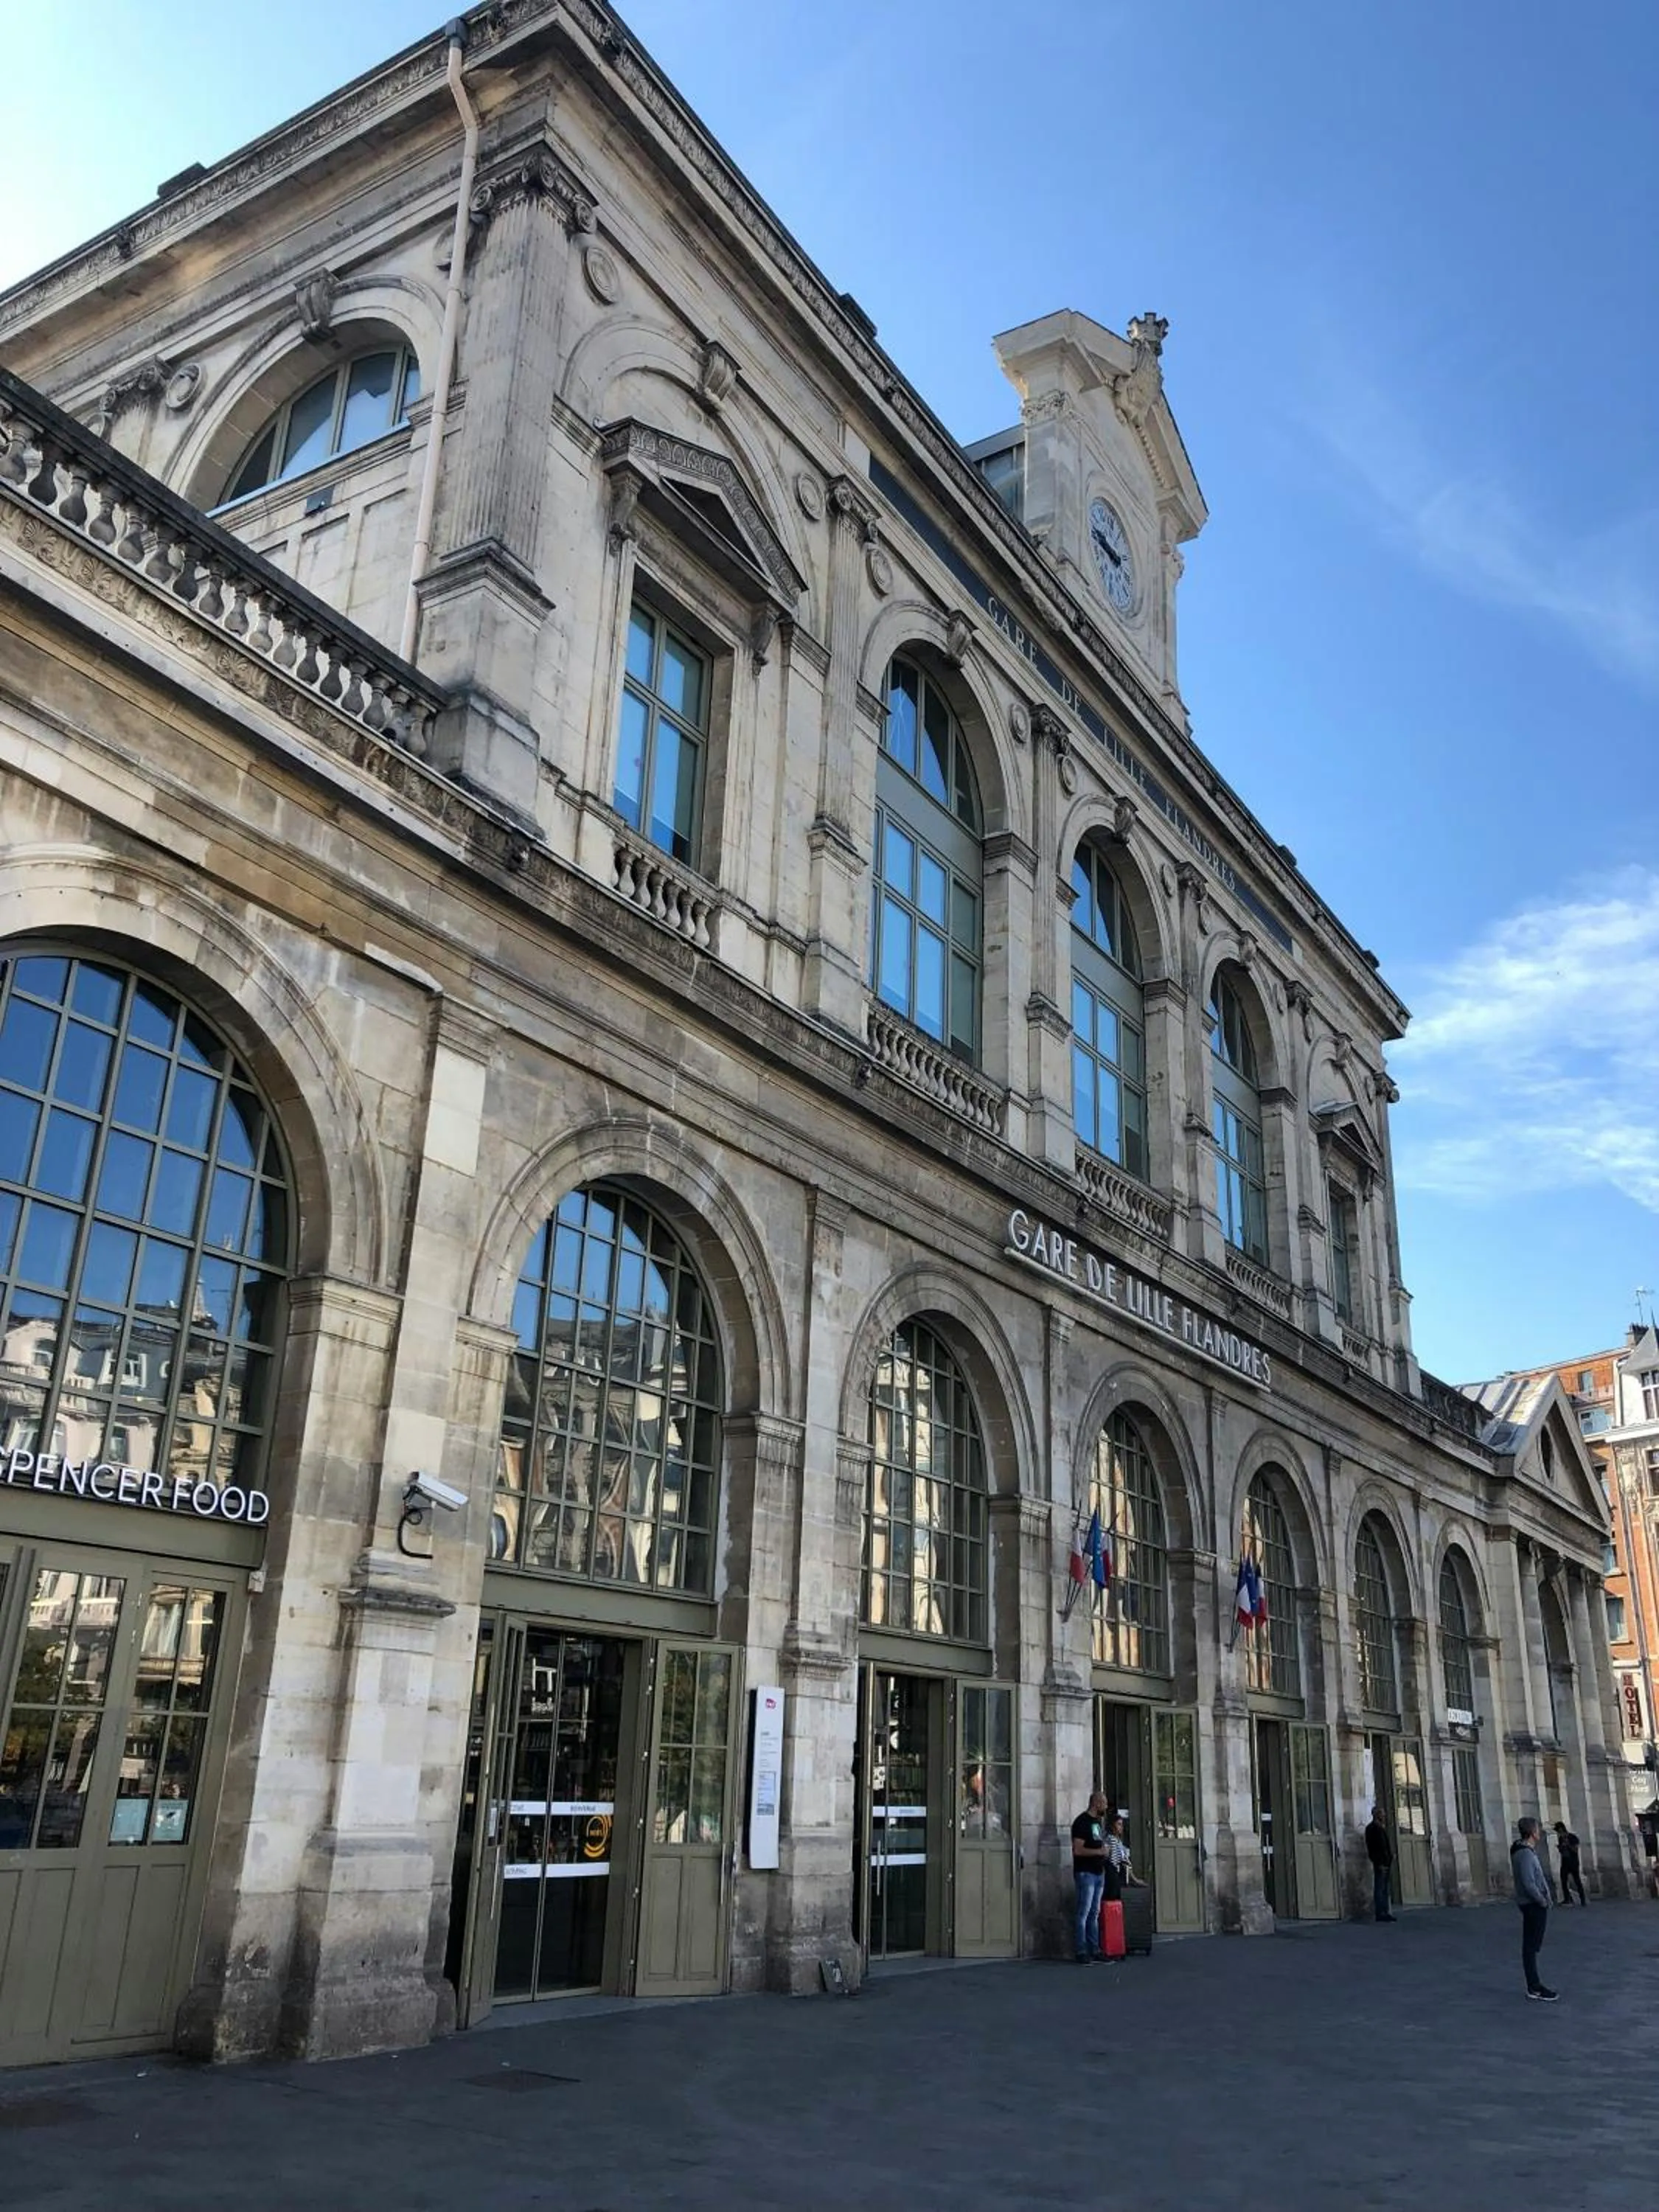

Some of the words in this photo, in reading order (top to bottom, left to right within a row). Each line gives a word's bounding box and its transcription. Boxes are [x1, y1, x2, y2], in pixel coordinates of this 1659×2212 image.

[989, 597, 1037, 669] GARE
[1062, 678, 1082, 720] DE
[1104, 726, 1147, 794] LILLE
[1166, 797, 1236, 891] FLANDRES
[1009, 1208, 1077, 1280] GARE
[1086, 1253, 1117, 1301] DE
[1127, 1275, 1175, 1332] LILLE
[1182, 1306, 1272, 1385] FLANDRES
[172, 1477, 269, 1523] FOOD
